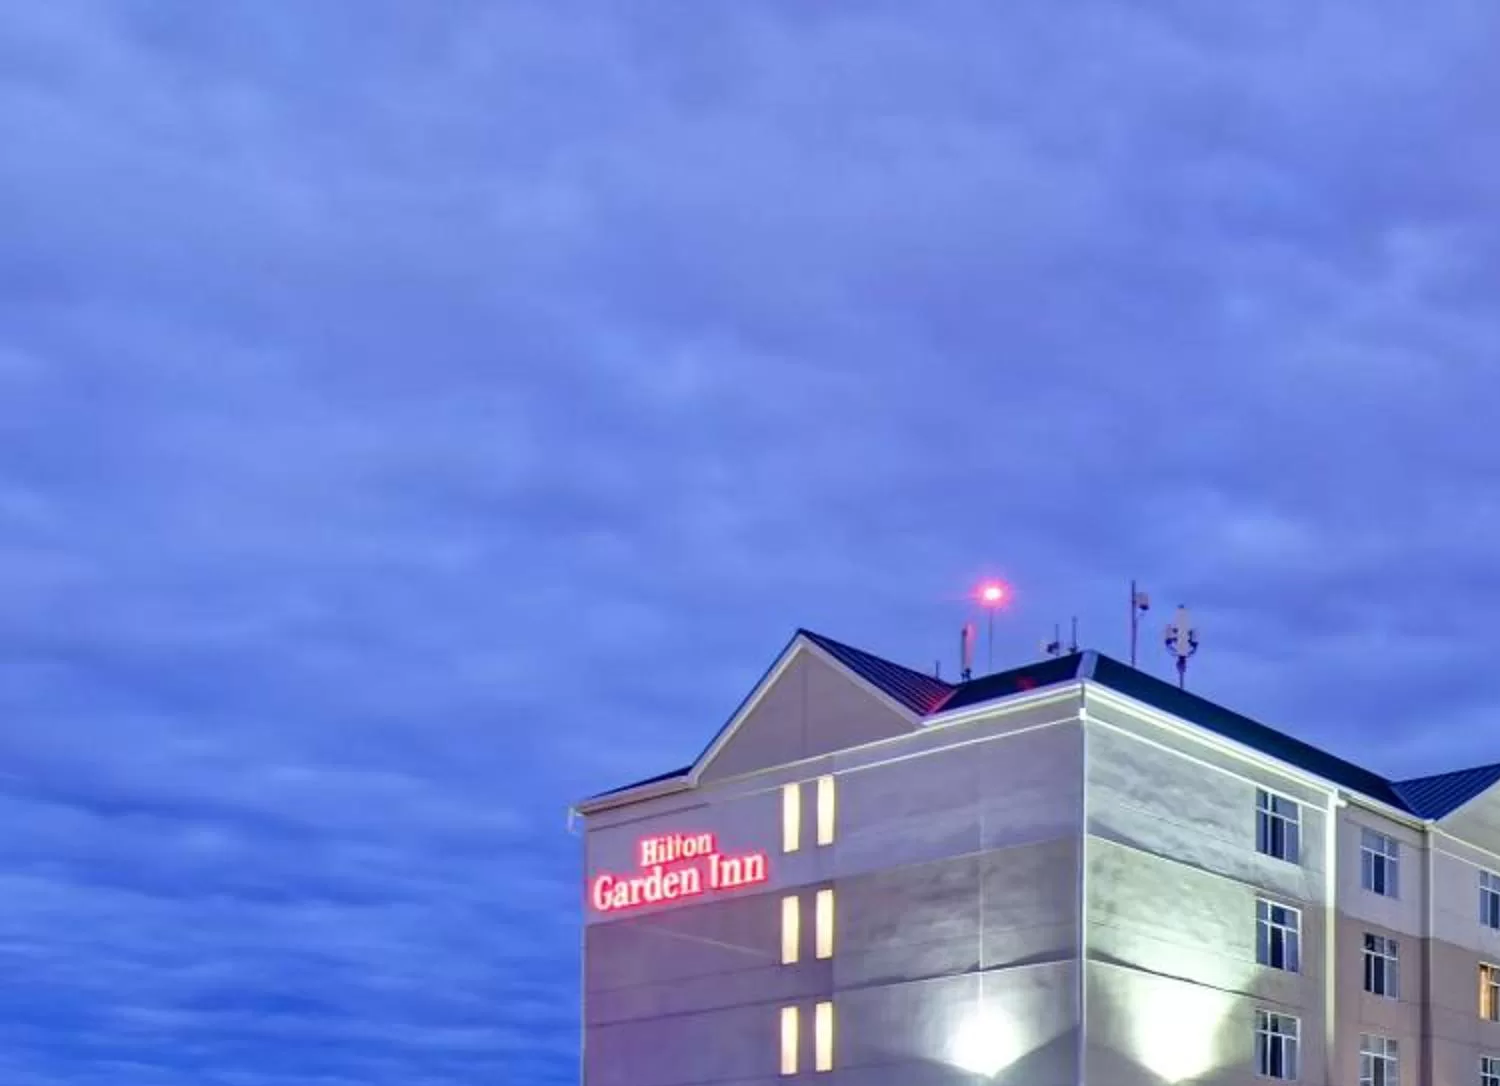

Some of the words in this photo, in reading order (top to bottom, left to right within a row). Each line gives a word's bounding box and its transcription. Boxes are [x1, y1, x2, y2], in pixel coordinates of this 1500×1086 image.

[640, 833, 713, 867] Hilton
[593, 866, 701, 911] Garden
[709, 853, 765, 889] Inn
